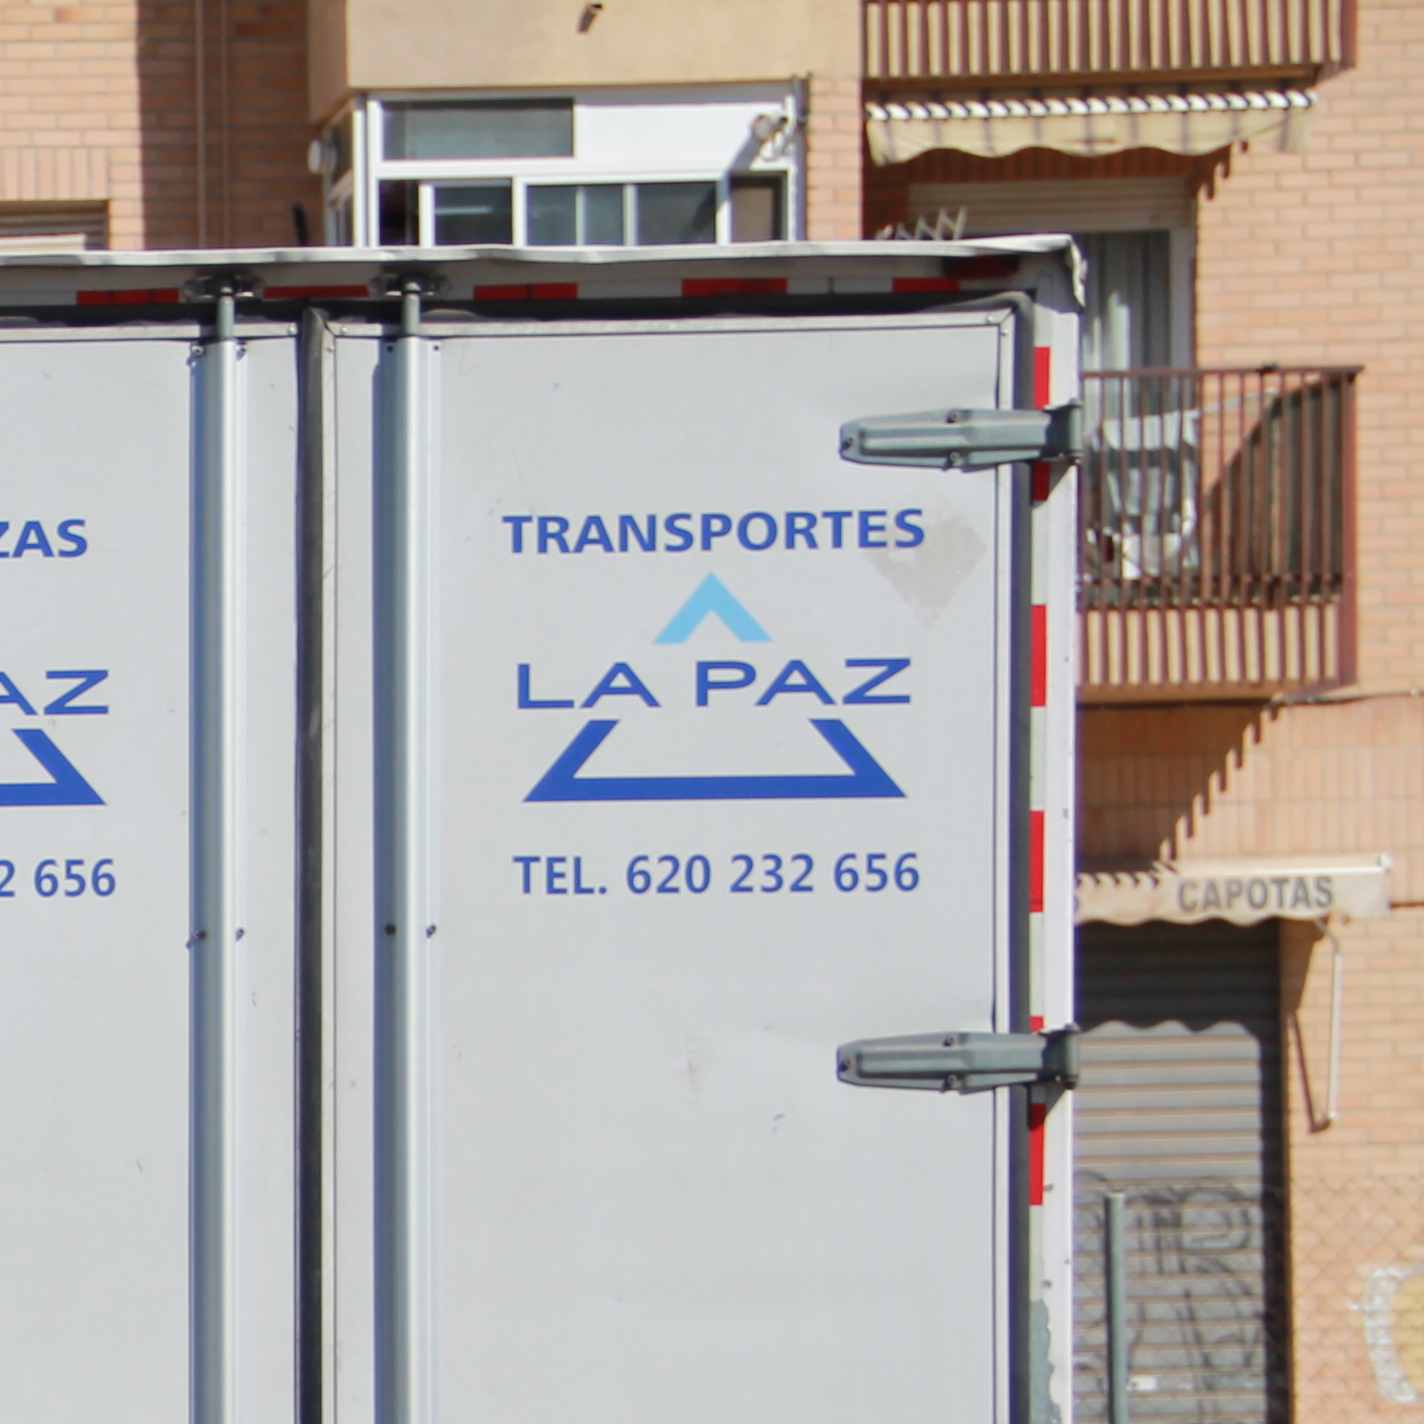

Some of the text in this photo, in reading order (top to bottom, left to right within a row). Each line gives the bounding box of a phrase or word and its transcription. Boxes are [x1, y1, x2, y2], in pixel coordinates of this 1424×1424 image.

[502, 508, 925, 553] TRANSPORTES
[517, 657, 911, 709] LA PAZ
[33, 858, 116, 897] 656
[512, 852, 920, 894] TEL. 620 232 656
[1177, 876, 1332, 912] CAPOTAS
